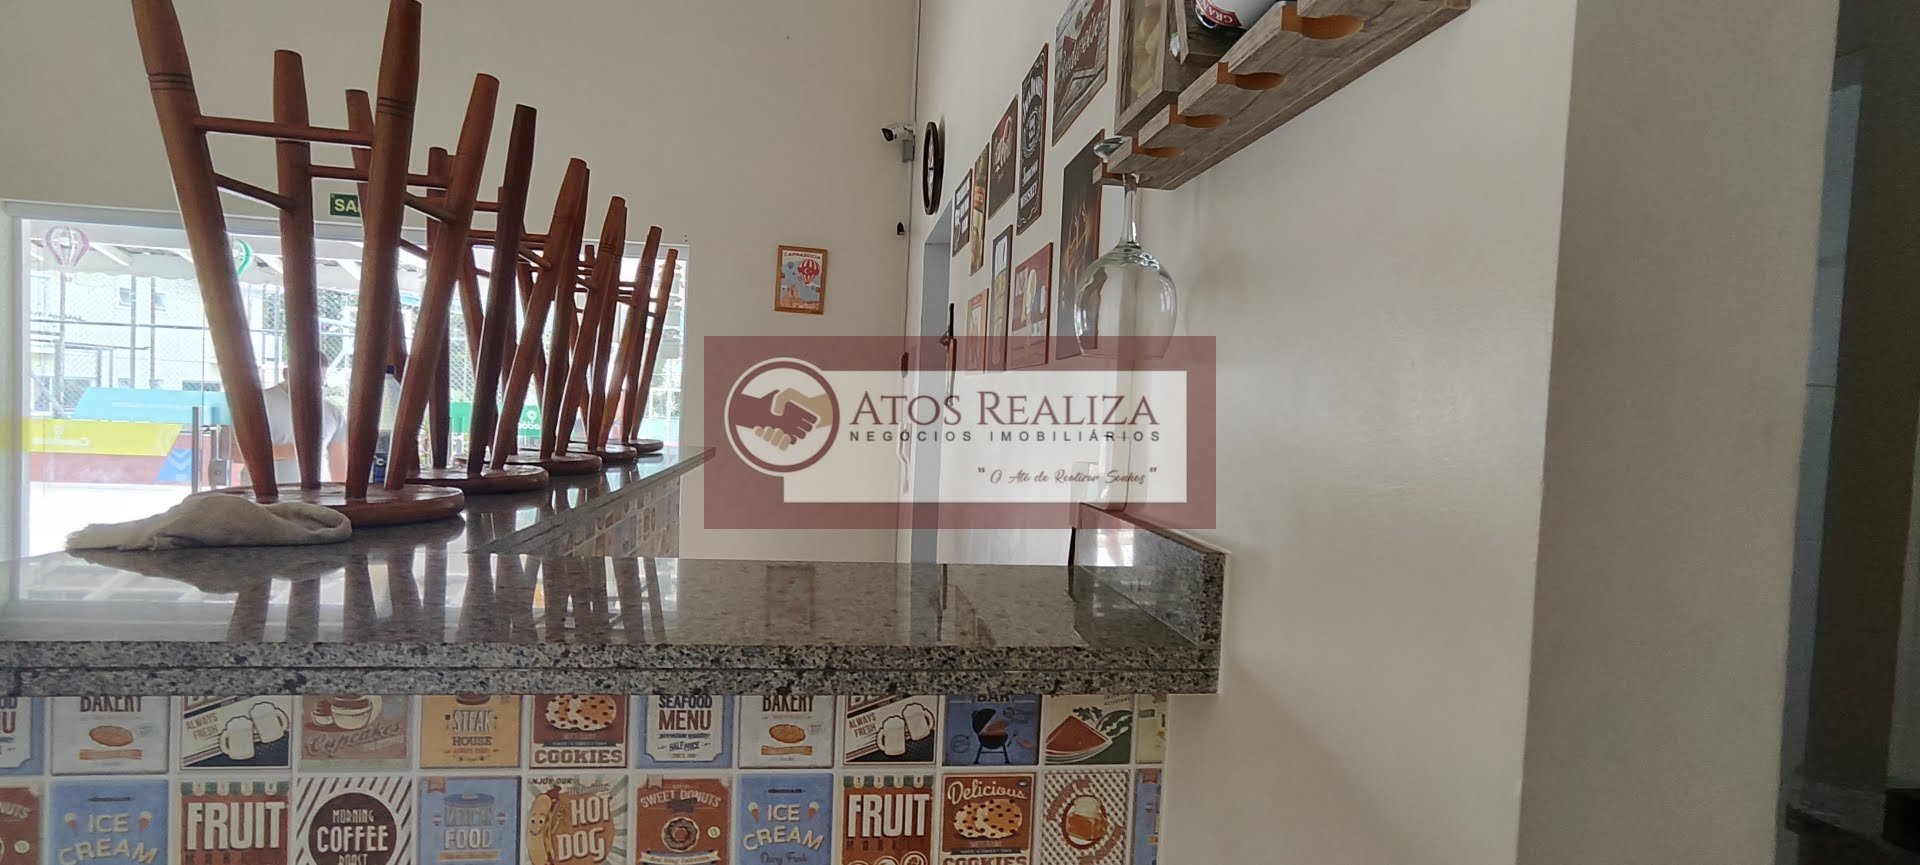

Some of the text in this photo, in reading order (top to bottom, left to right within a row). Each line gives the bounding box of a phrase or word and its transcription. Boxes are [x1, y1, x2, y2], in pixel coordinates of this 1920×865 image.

[334, 198, 359, 213] SA
[784, 251, 821, 260] CAPPADOCIA
[658, 694, 713, 708] SEAFOOD
[762, 694, 814, 712] BAKERY
[186, 712, 218, 731] ALWAYS
[453, 710, 492, 732] STEAK
[658, 710, 712, 730] MENU
[849, 712, 877, 729] ALWAYS
[193, 724, 219, 740] FRESH
[307, 718, 401, 757] Cupcakes
[854, 723, 877, 737] FRESH
[452, 736, 493, 746] HOUSE
[534, 749, 623, 764] COOKIES
[639, 789, 722, 808] SWEET DONUTS
[947, 779, 1028, 805] Delicious
[332, 809, 375, 823] MORNING
[570, 792, 613, 827] HOT
[767, 803, 801, 822] ICE
[847, 794, 930, 838] FRUIT
[88, 814, 129, 833] ICE
[186, 801, 285, 850] FRUIT
[316, 825, 390, 853] COFFEE
[444, 829, 492, 849] FOOD
[556, 827, 606, 862] DOG
[742, 824, 825, 851] CREAM
[57, 837, 159, 865] CREAM
